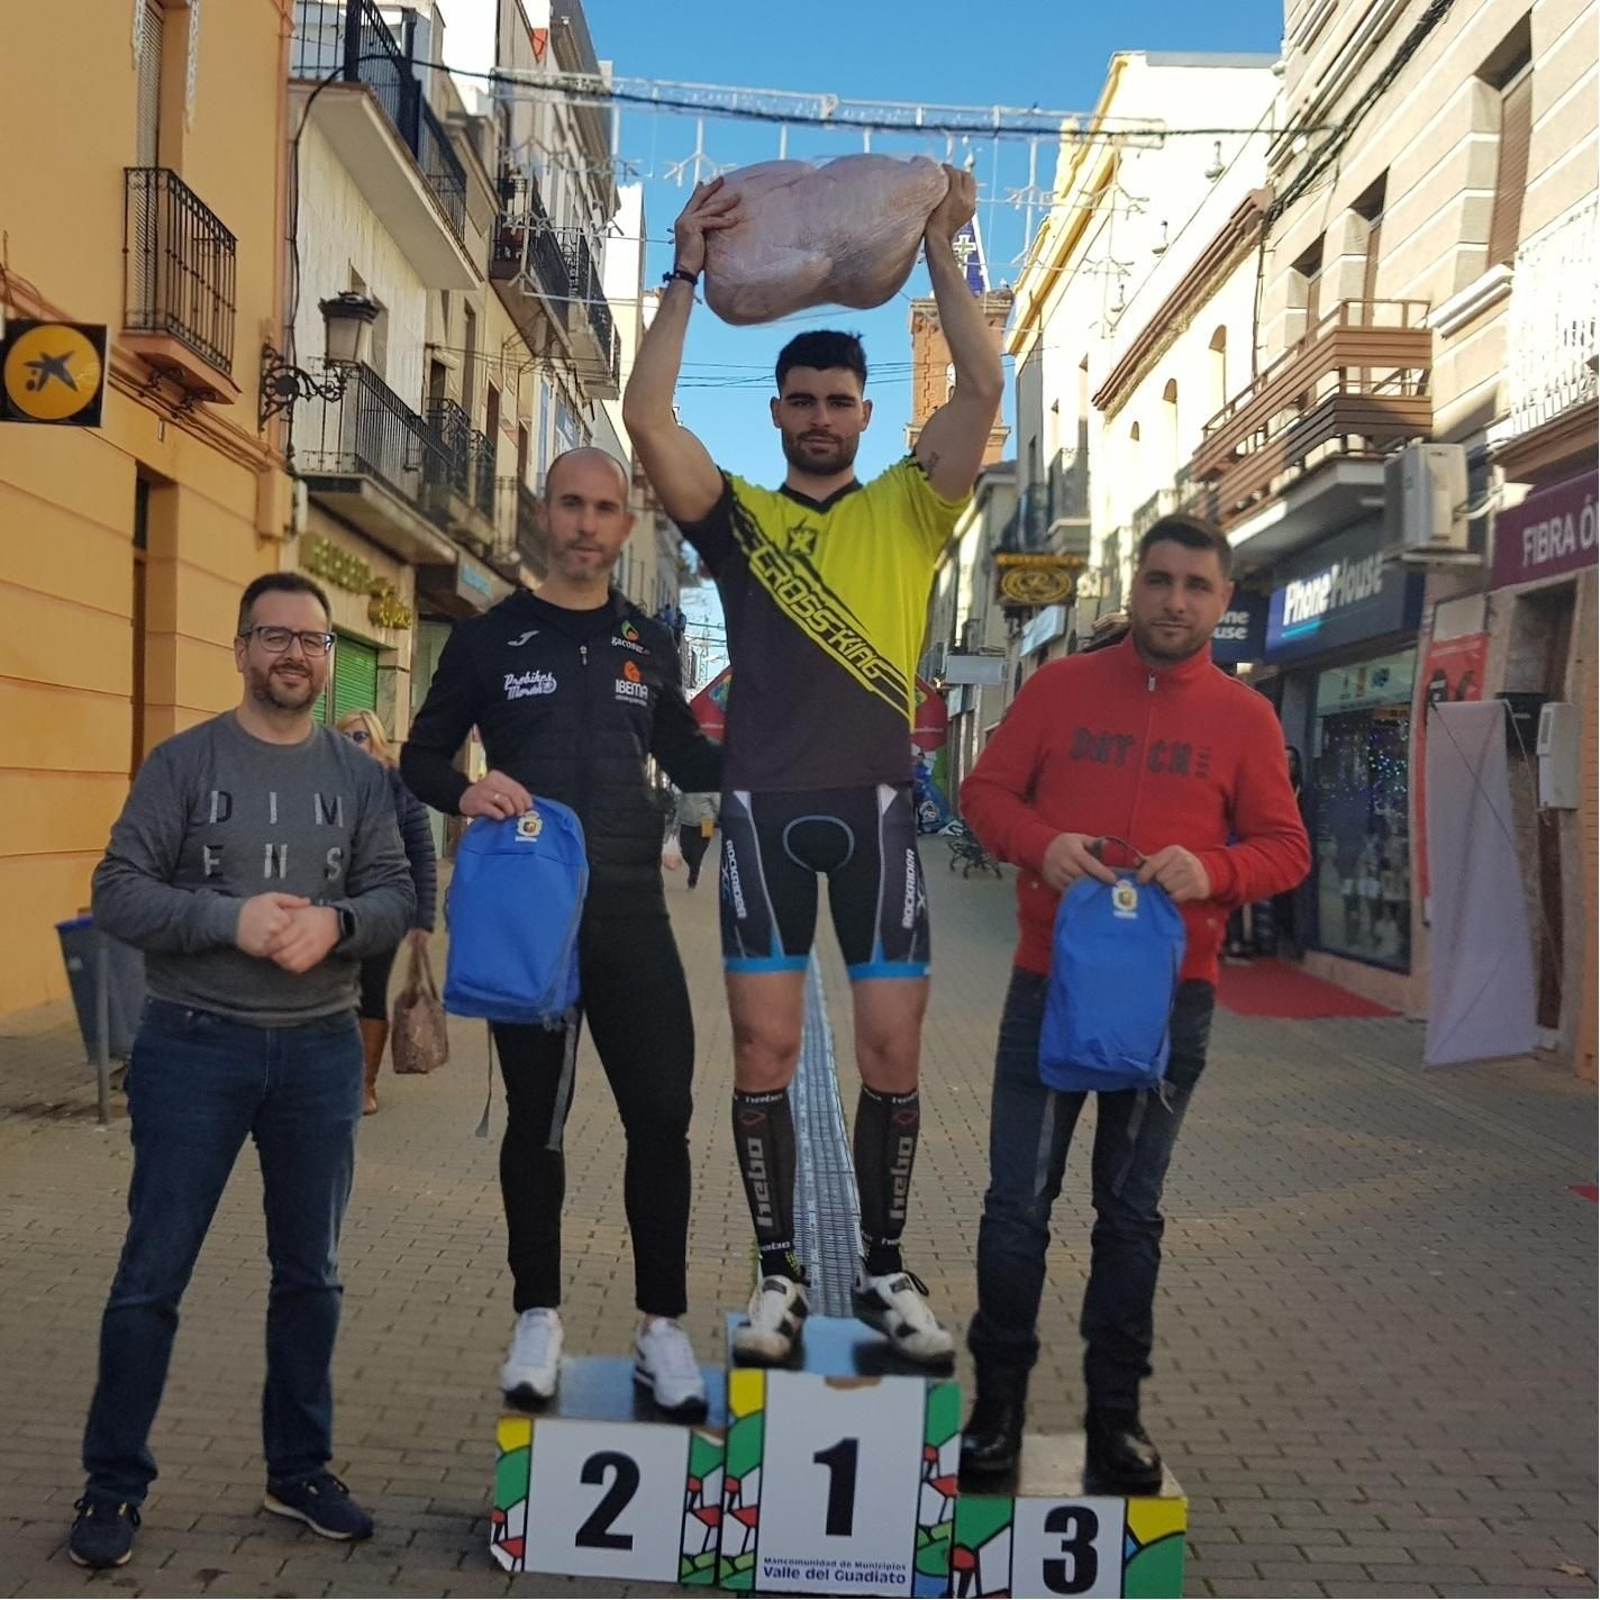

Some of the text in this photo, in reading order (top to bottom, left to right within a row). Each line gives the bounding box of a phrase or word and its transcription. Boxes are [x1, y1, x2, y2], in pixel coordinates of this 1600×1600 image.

[1522, 494, 1598, 568] FIBRA Ó
[1283, 553, 1384, 626] Phone House
[615, 679, 648, 700] IBEMA
[748, 1137, 773, 1227] hebo
[890, 1136, 914, 1219] hebo
[575, 1451, 640, 1551] 2
[813, 1437, 860, 1537] 1
[763, 1566, 906, 1584] Valle del Guadiato
[764, 1557, 906, 1571] Mancomunidad de Municipios
[1043, 1505, 1099, 1595] 3
